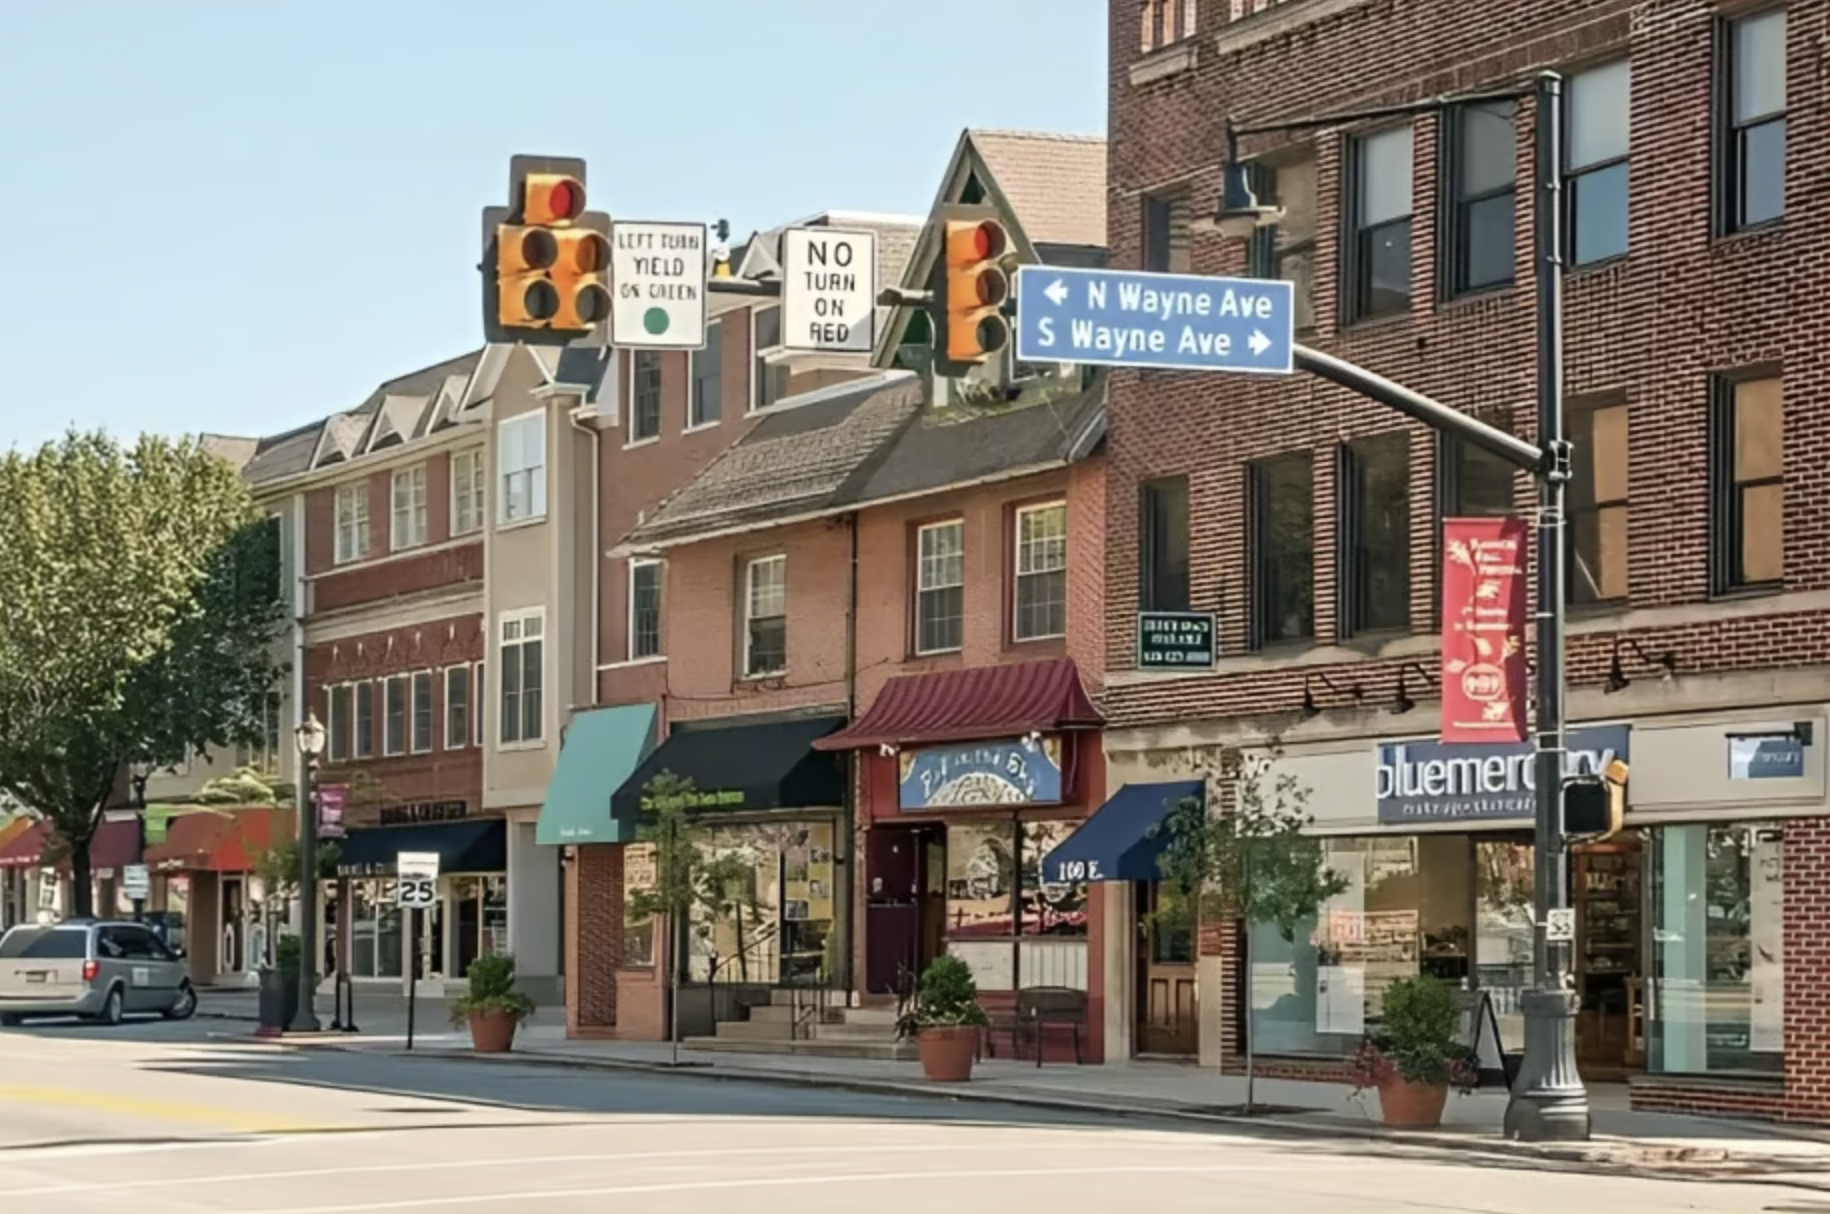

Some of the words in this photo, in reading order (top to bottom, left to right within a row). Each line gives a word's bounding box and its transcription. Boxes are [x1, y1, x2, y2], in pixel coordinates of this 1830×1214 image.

[618, 233, 654, 250] LEFT
[807, 240, 853, 268] NO
[632, 256, 685, 277] YIELD
[803, 271, 855, 292] TURN
[814, 297, 844, 317] ON
[1087, 280, 1107, 310] N
[1118, 281, 1211, 320] Wayne
[1219, 288, 1273, 318] Ave
[809, 321, 850, 344] RED
[1037, 316, 1055, 347] S
[1070, 318, 1165, 357] Wayne
[1177, 325, 1231, 356] Ave
[401, 881, 434, 902] 25
